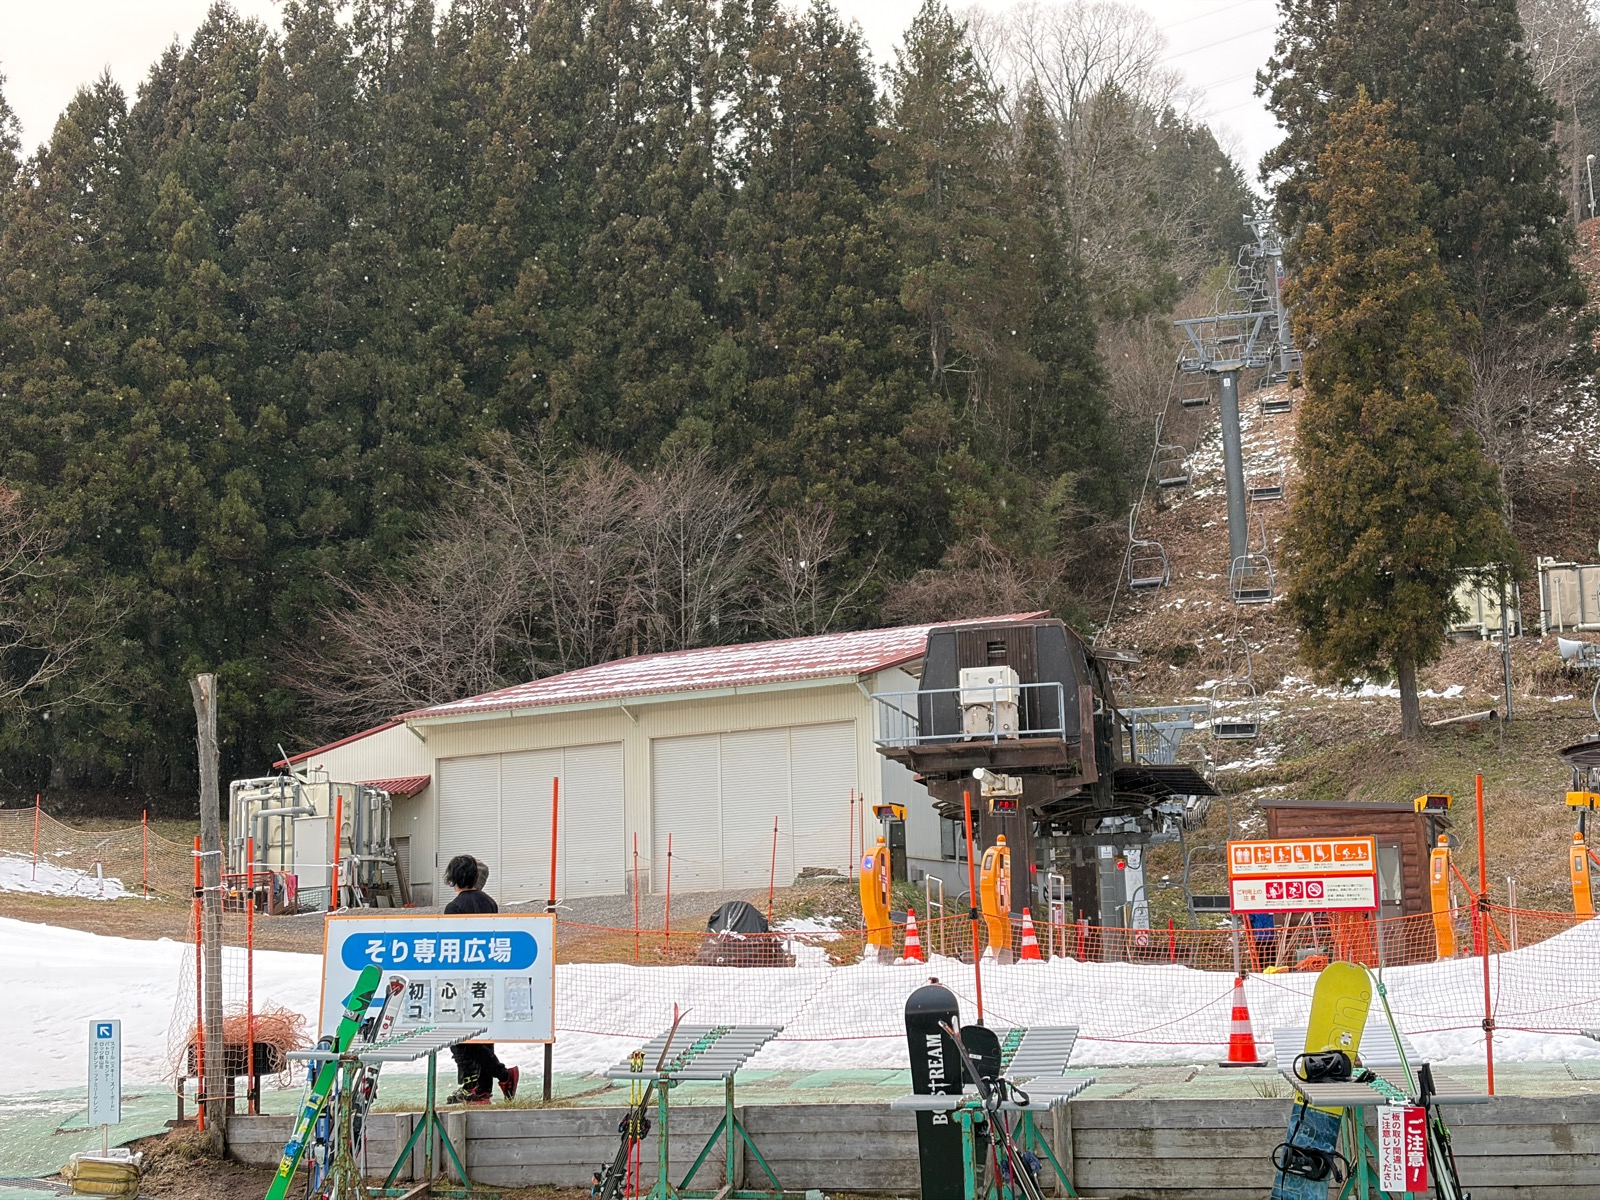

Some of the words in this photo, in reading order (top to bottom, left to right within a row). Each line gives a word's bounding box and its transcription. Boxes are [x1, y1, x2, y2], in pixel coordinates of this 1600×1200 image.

[365, 937, 512, 964] そり専用広場
[408, 981, 488, 1000] 初心者
[408, 1003, 487, 1019] コース
[1382, 1112, 1393, 1190] ご注意してください
[1391, 1112, 1402, 1181] 板の取り間違いに
